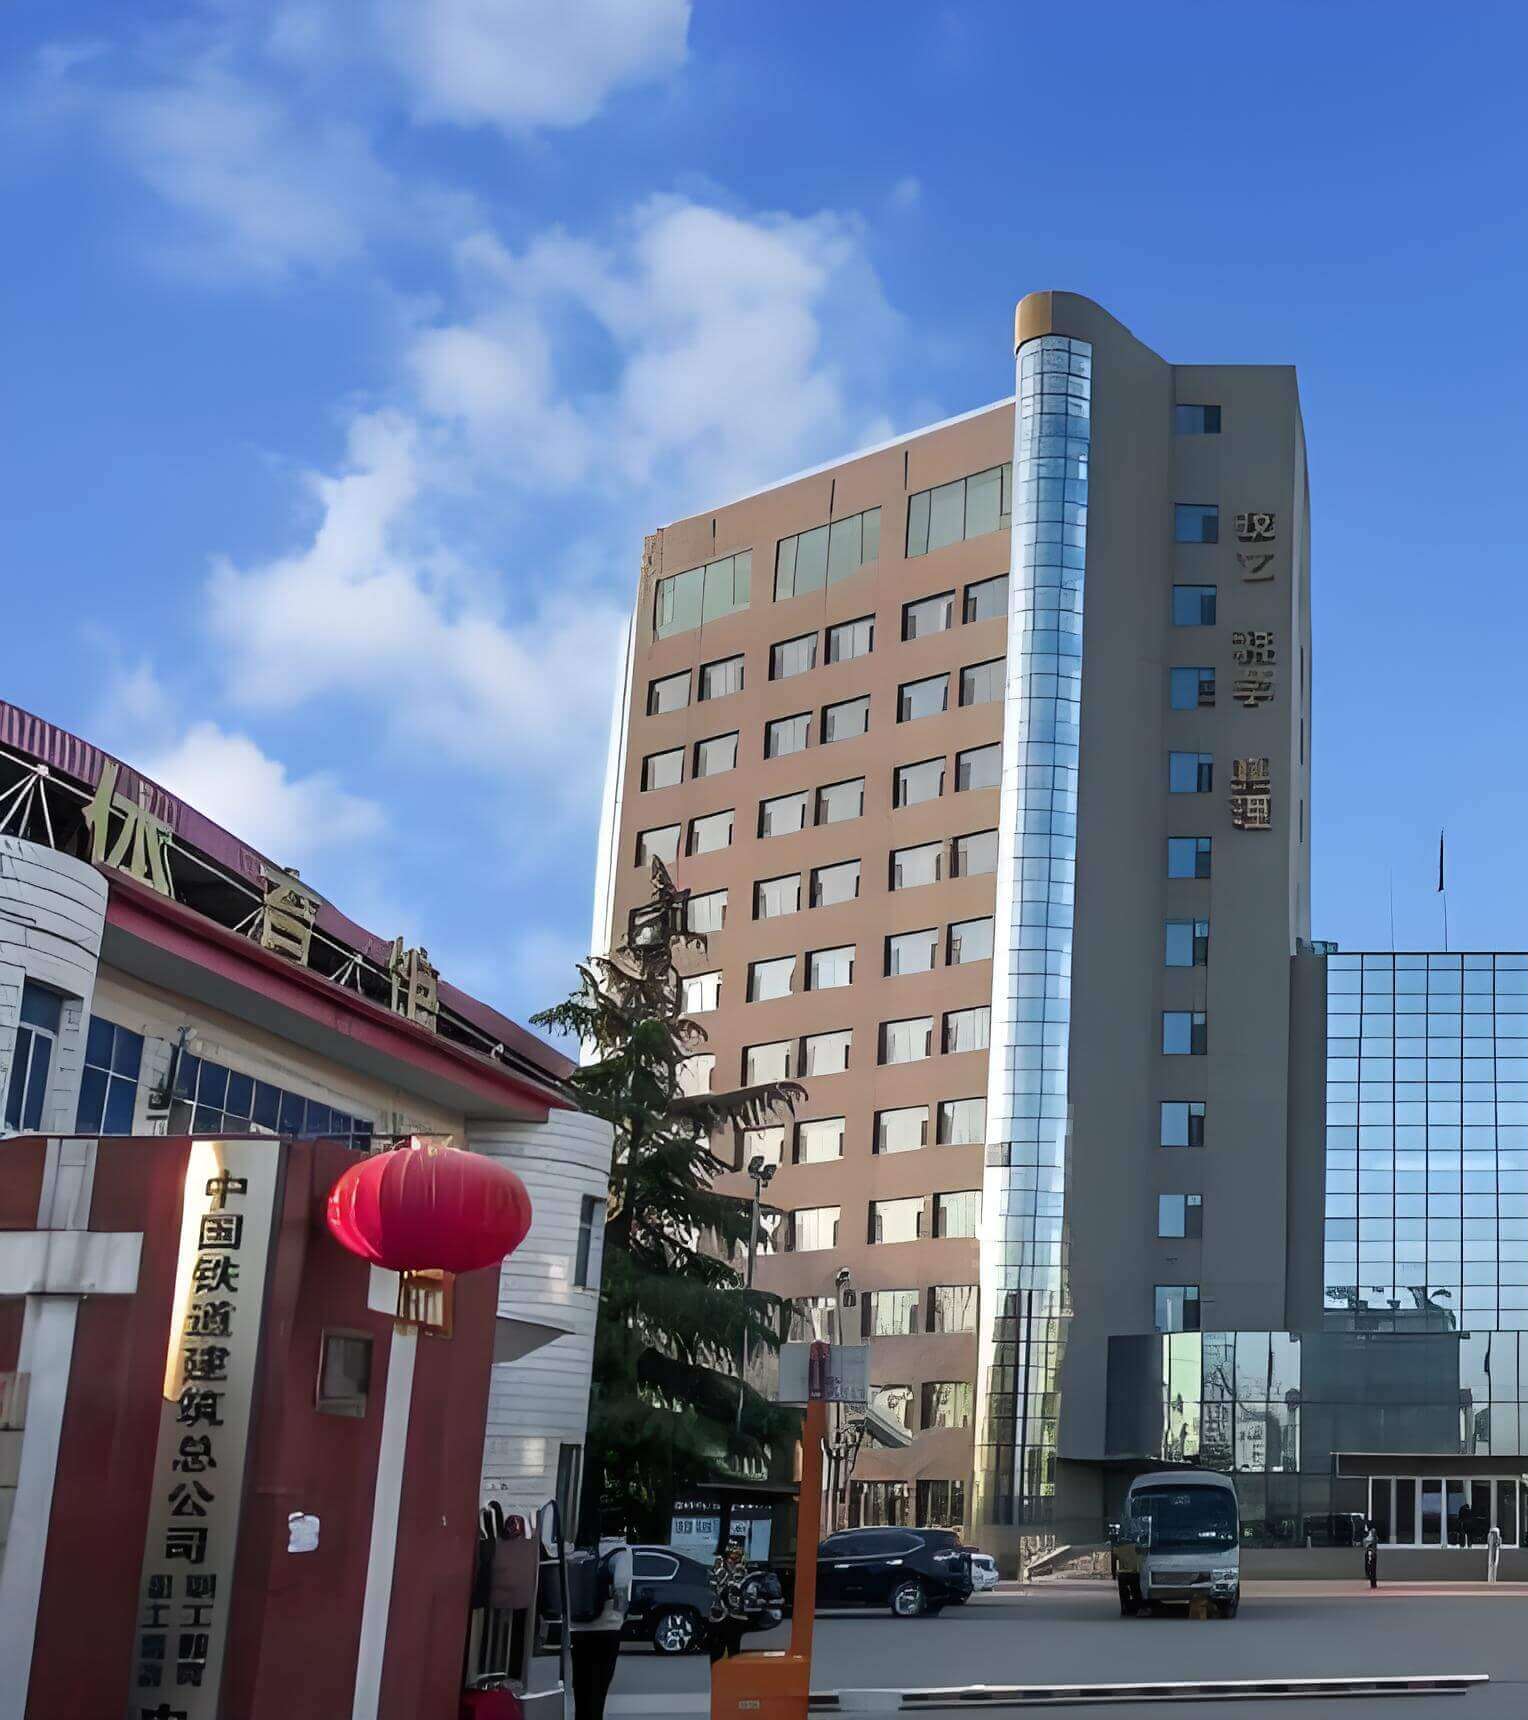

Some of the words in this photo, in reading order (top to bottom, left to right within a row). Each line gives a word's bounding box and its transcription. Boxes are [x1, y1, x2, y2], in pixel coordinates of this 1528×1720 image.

[165, 1169, 248, 1565] 中国铁道建筑总公司
